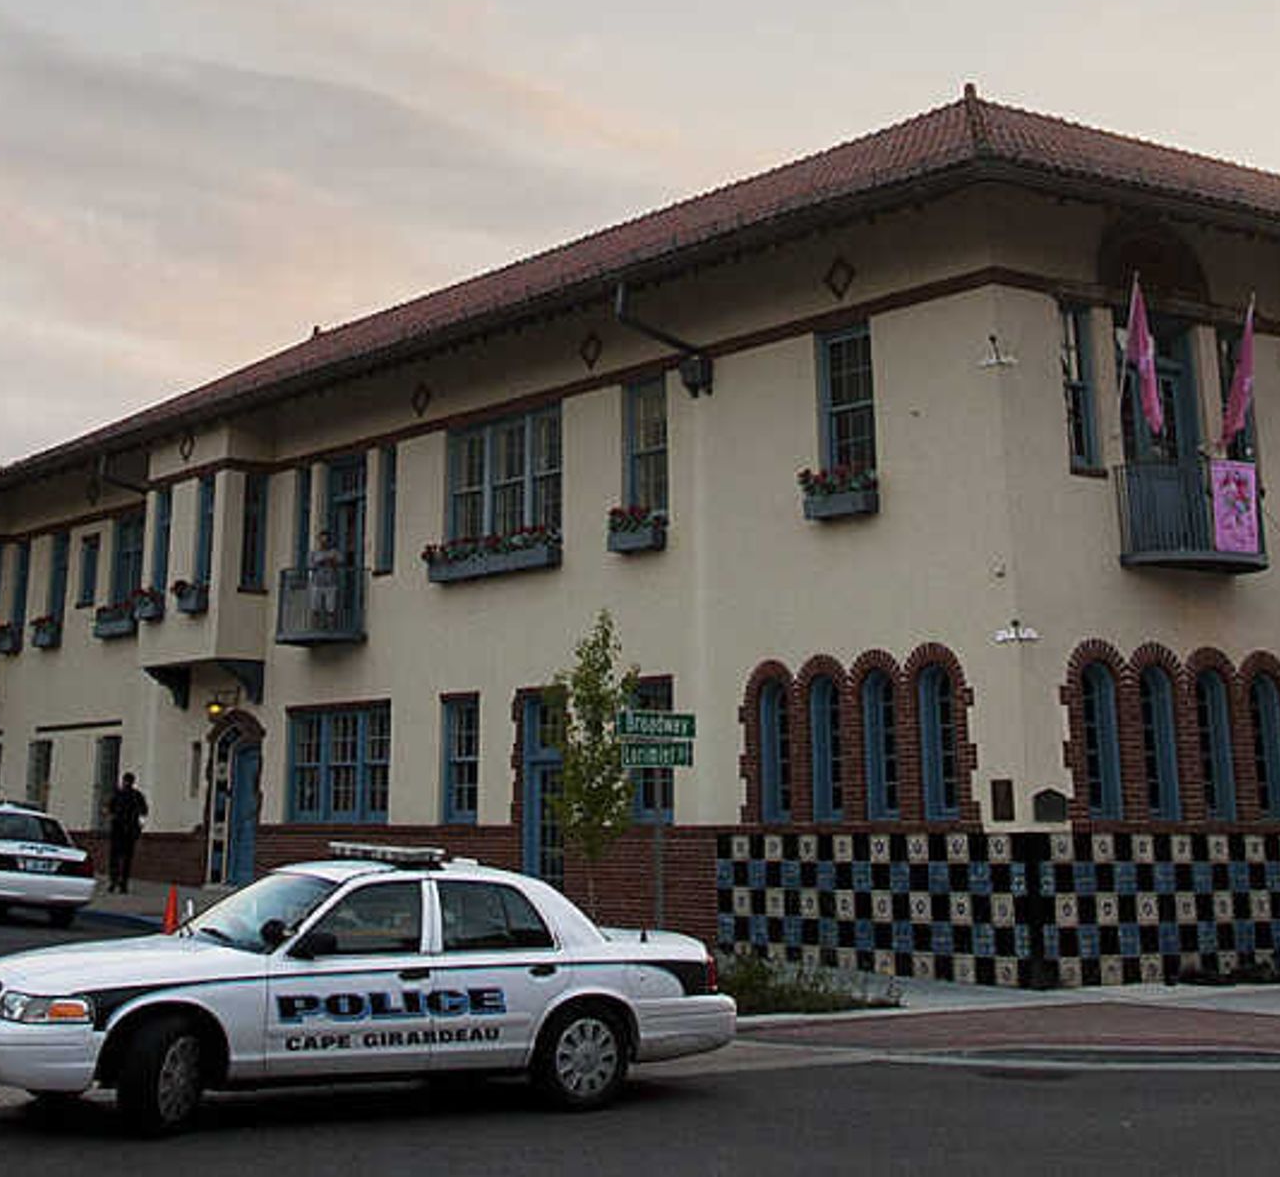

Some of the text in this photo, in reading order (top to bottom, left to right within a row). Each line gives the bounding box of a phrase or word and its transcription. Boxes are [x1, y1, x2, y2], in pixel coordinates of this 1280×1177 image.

[277, 988, 507, 1023] POLICE
[286, 1027, 500, 1051] CAPE GIRARDEAU
